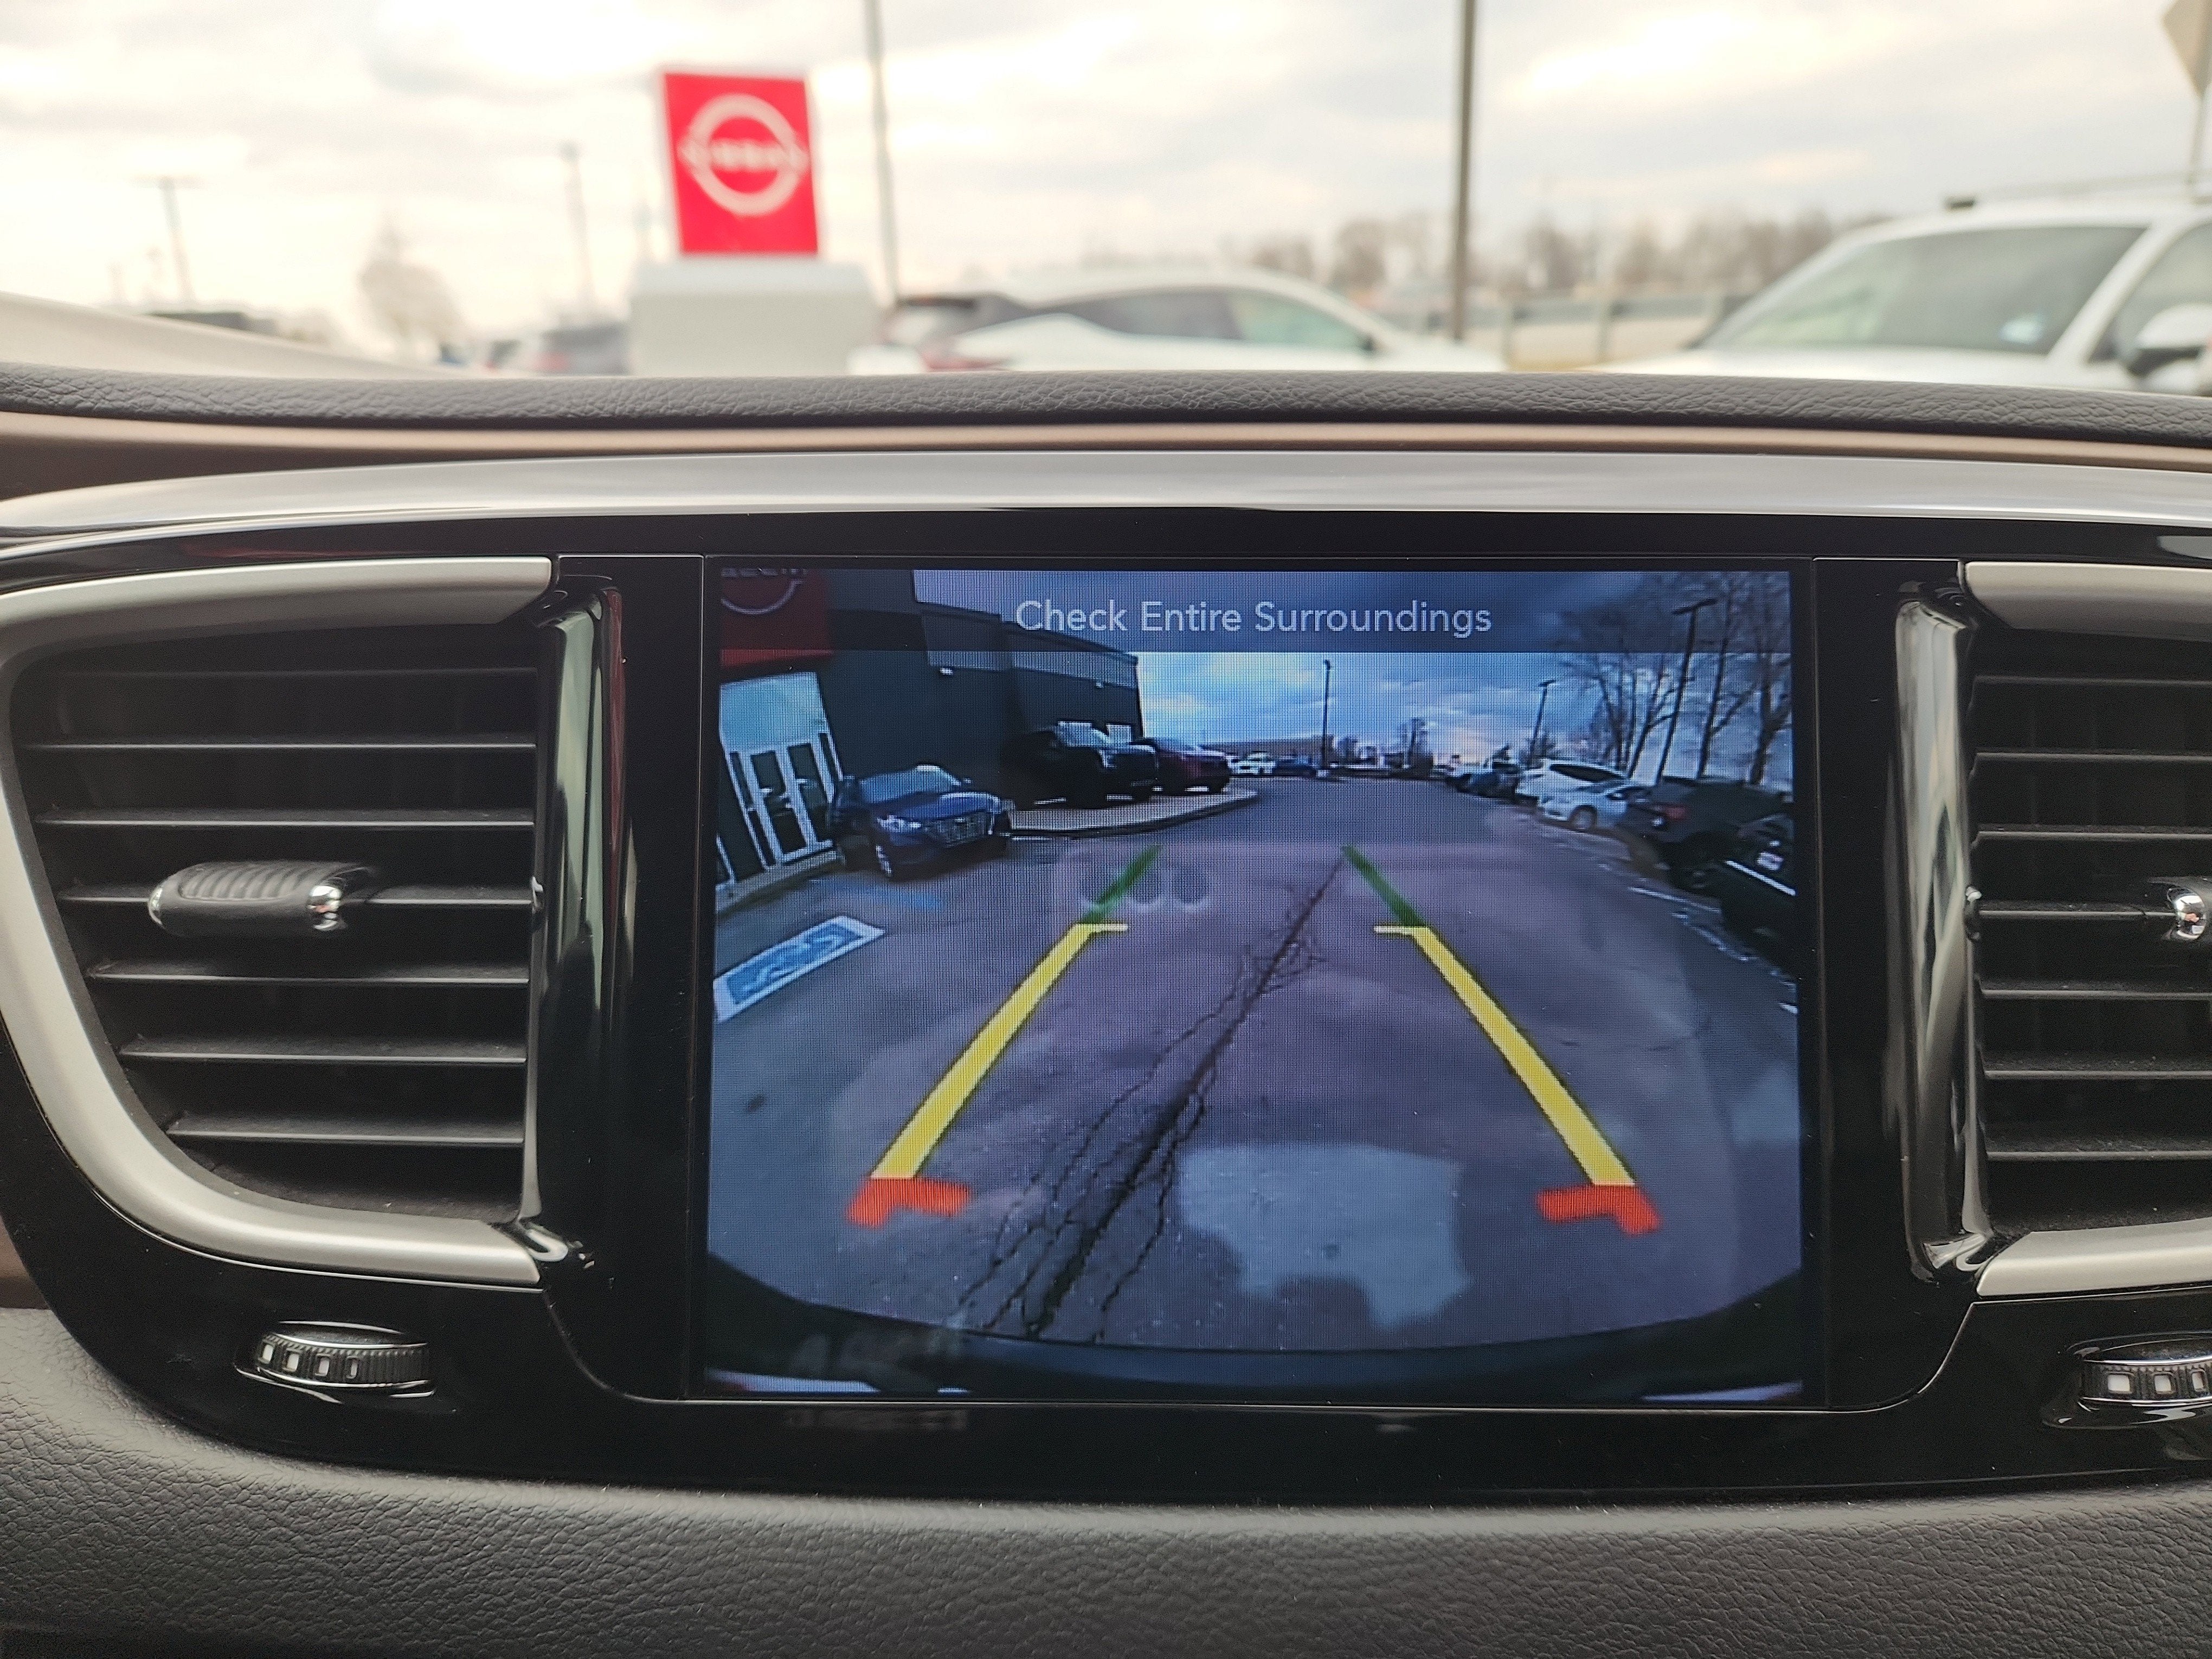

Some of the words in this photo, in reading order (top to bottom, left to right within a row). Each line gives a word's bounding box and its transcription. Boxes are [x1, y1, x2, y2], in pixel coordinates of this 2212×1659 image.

[1017, 599, 1127, 631] Check
[1141, 600, 1242, 631] Entire
[1255, 600, 1492, 638] Surroundings
